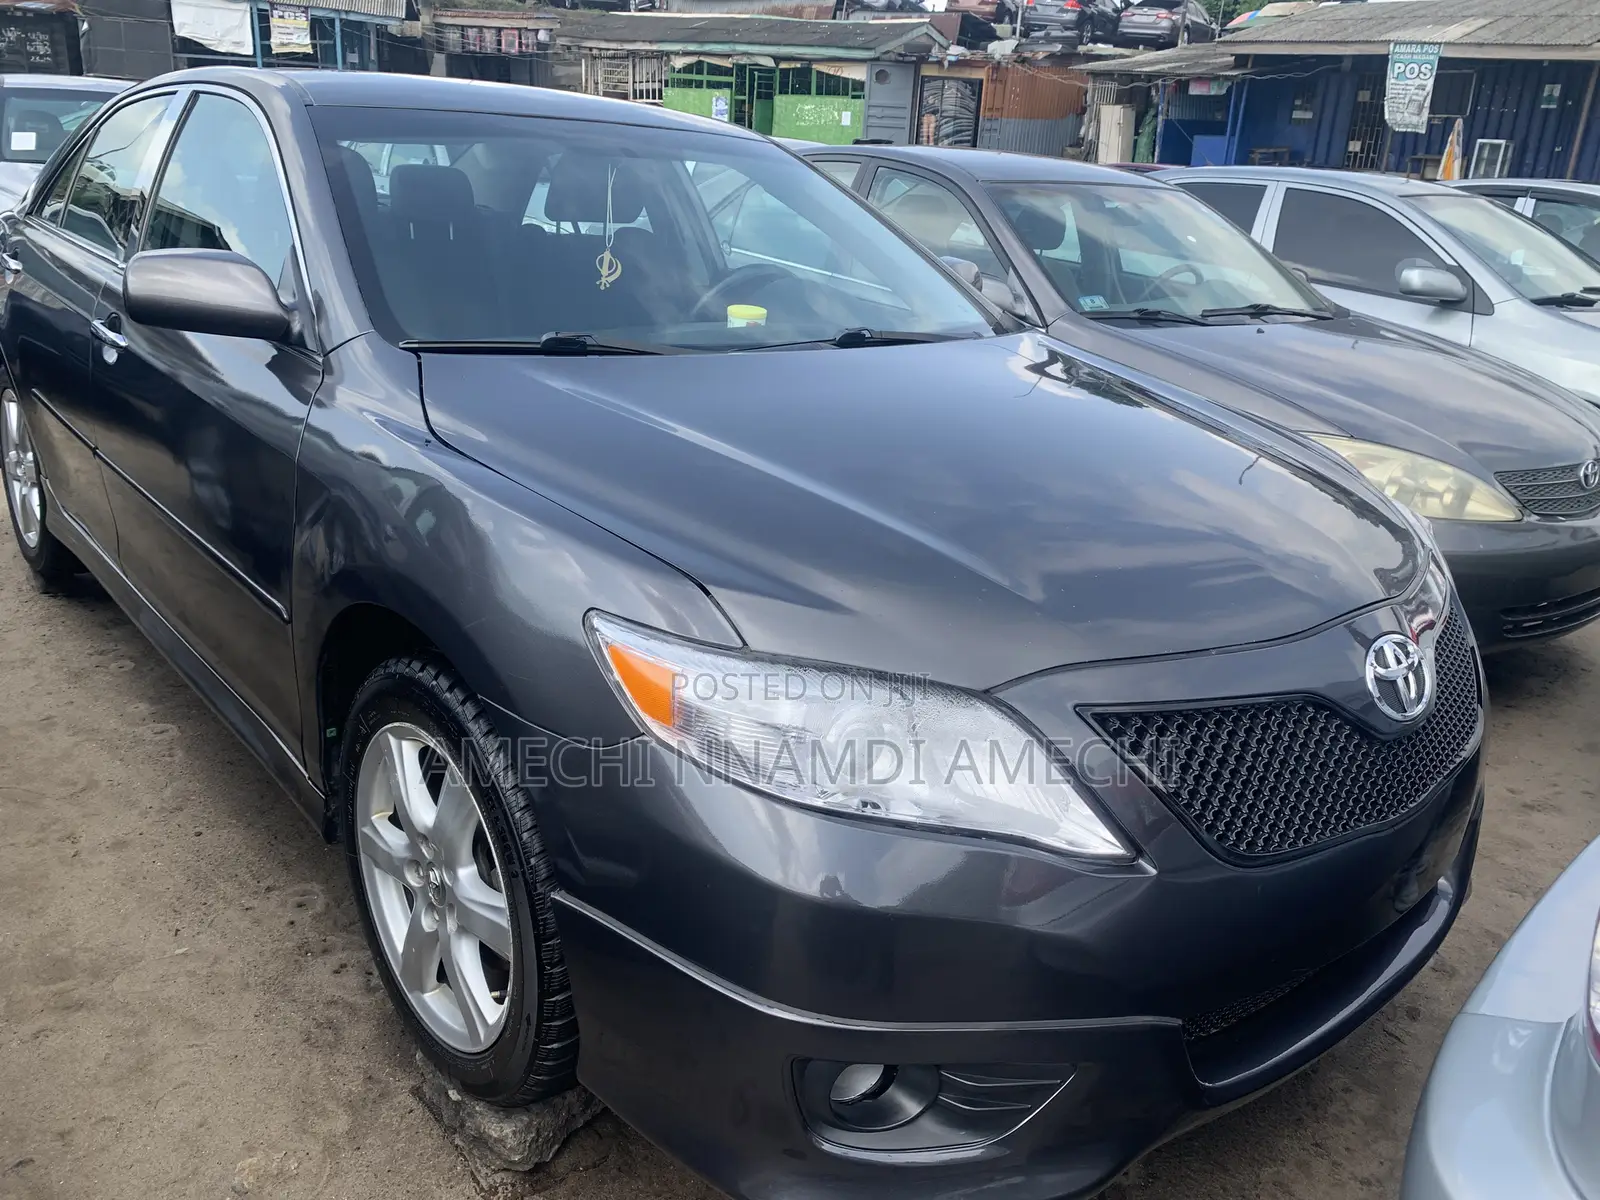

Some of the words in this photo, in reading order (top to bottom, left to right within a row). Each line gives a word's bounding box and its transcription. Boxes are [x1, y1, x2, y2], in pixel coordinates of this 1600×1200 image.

[1394, 43, 1421, 53] AMARA
[1422, 44, 1440, 54] POS
[1392, 61, 1433, 80] POS
